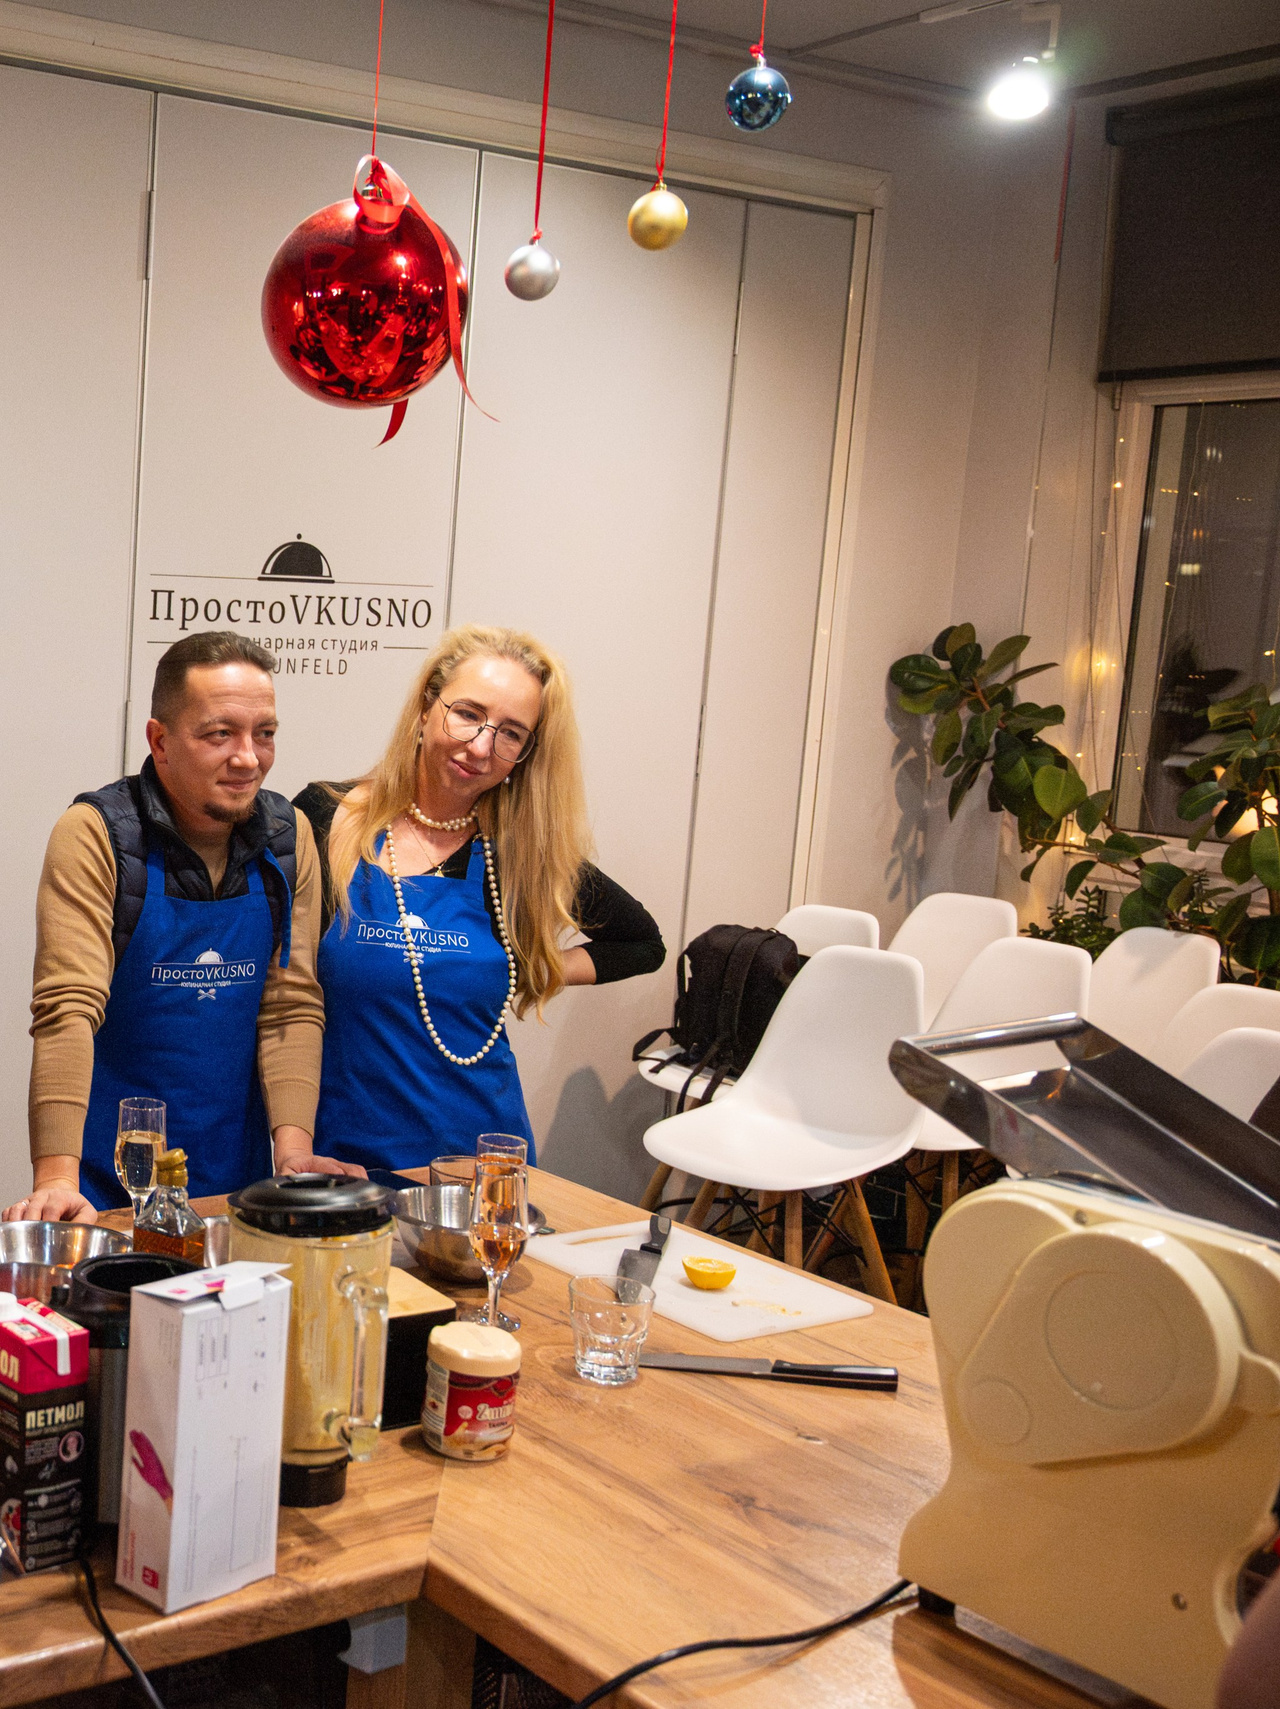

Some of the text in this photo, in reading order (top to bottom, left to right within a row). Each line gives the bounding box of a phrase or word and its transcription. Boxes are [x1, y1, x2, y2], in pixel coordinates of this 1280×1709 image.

[149, 589, 432, 631] ПростоVKUSNO
[321, 638, 379, 654] студия
[272, 657, 349, 675] UNFELD
[151, 963, 256, 982] ПростоVKUSNO
[26, 1400, 85, 1429] ПЕТМОЛ
